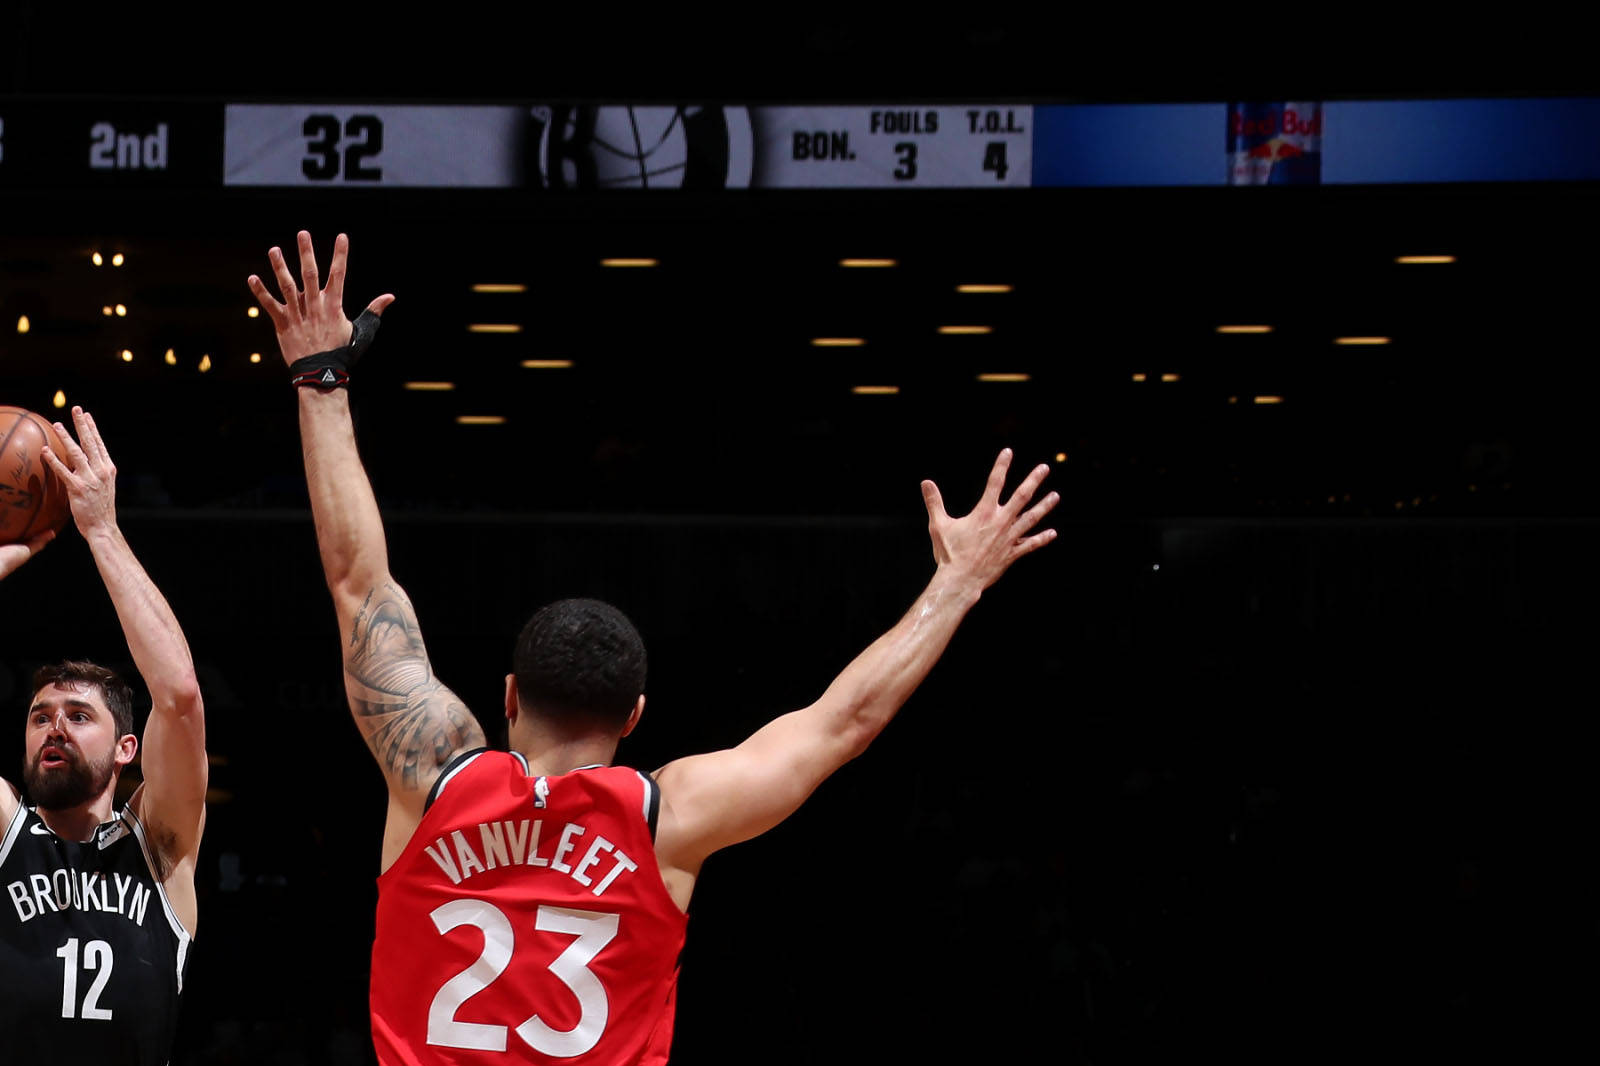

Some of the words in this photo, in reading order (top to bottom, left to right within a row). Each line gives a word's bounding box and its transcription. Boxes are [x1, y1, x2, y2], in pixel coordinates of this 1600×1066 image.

[89, 122, 167, 168] 2nd
[302, 114, 383, 181] 32
[793, 131, 855, 161] BON.
[870, 110, 938, 133] FOULS
[967, 110, 1024, 133] T.O.L.
[894, 143, 917, 179] 3
[984, 142, 1007, 179] 4
[424, 819, 638, 896] VANVLEET
[7, 868, 151, 926] BROOKLYN
[56, 937, 114, 1020] 12
[426, 898, 620, 1058] 23
